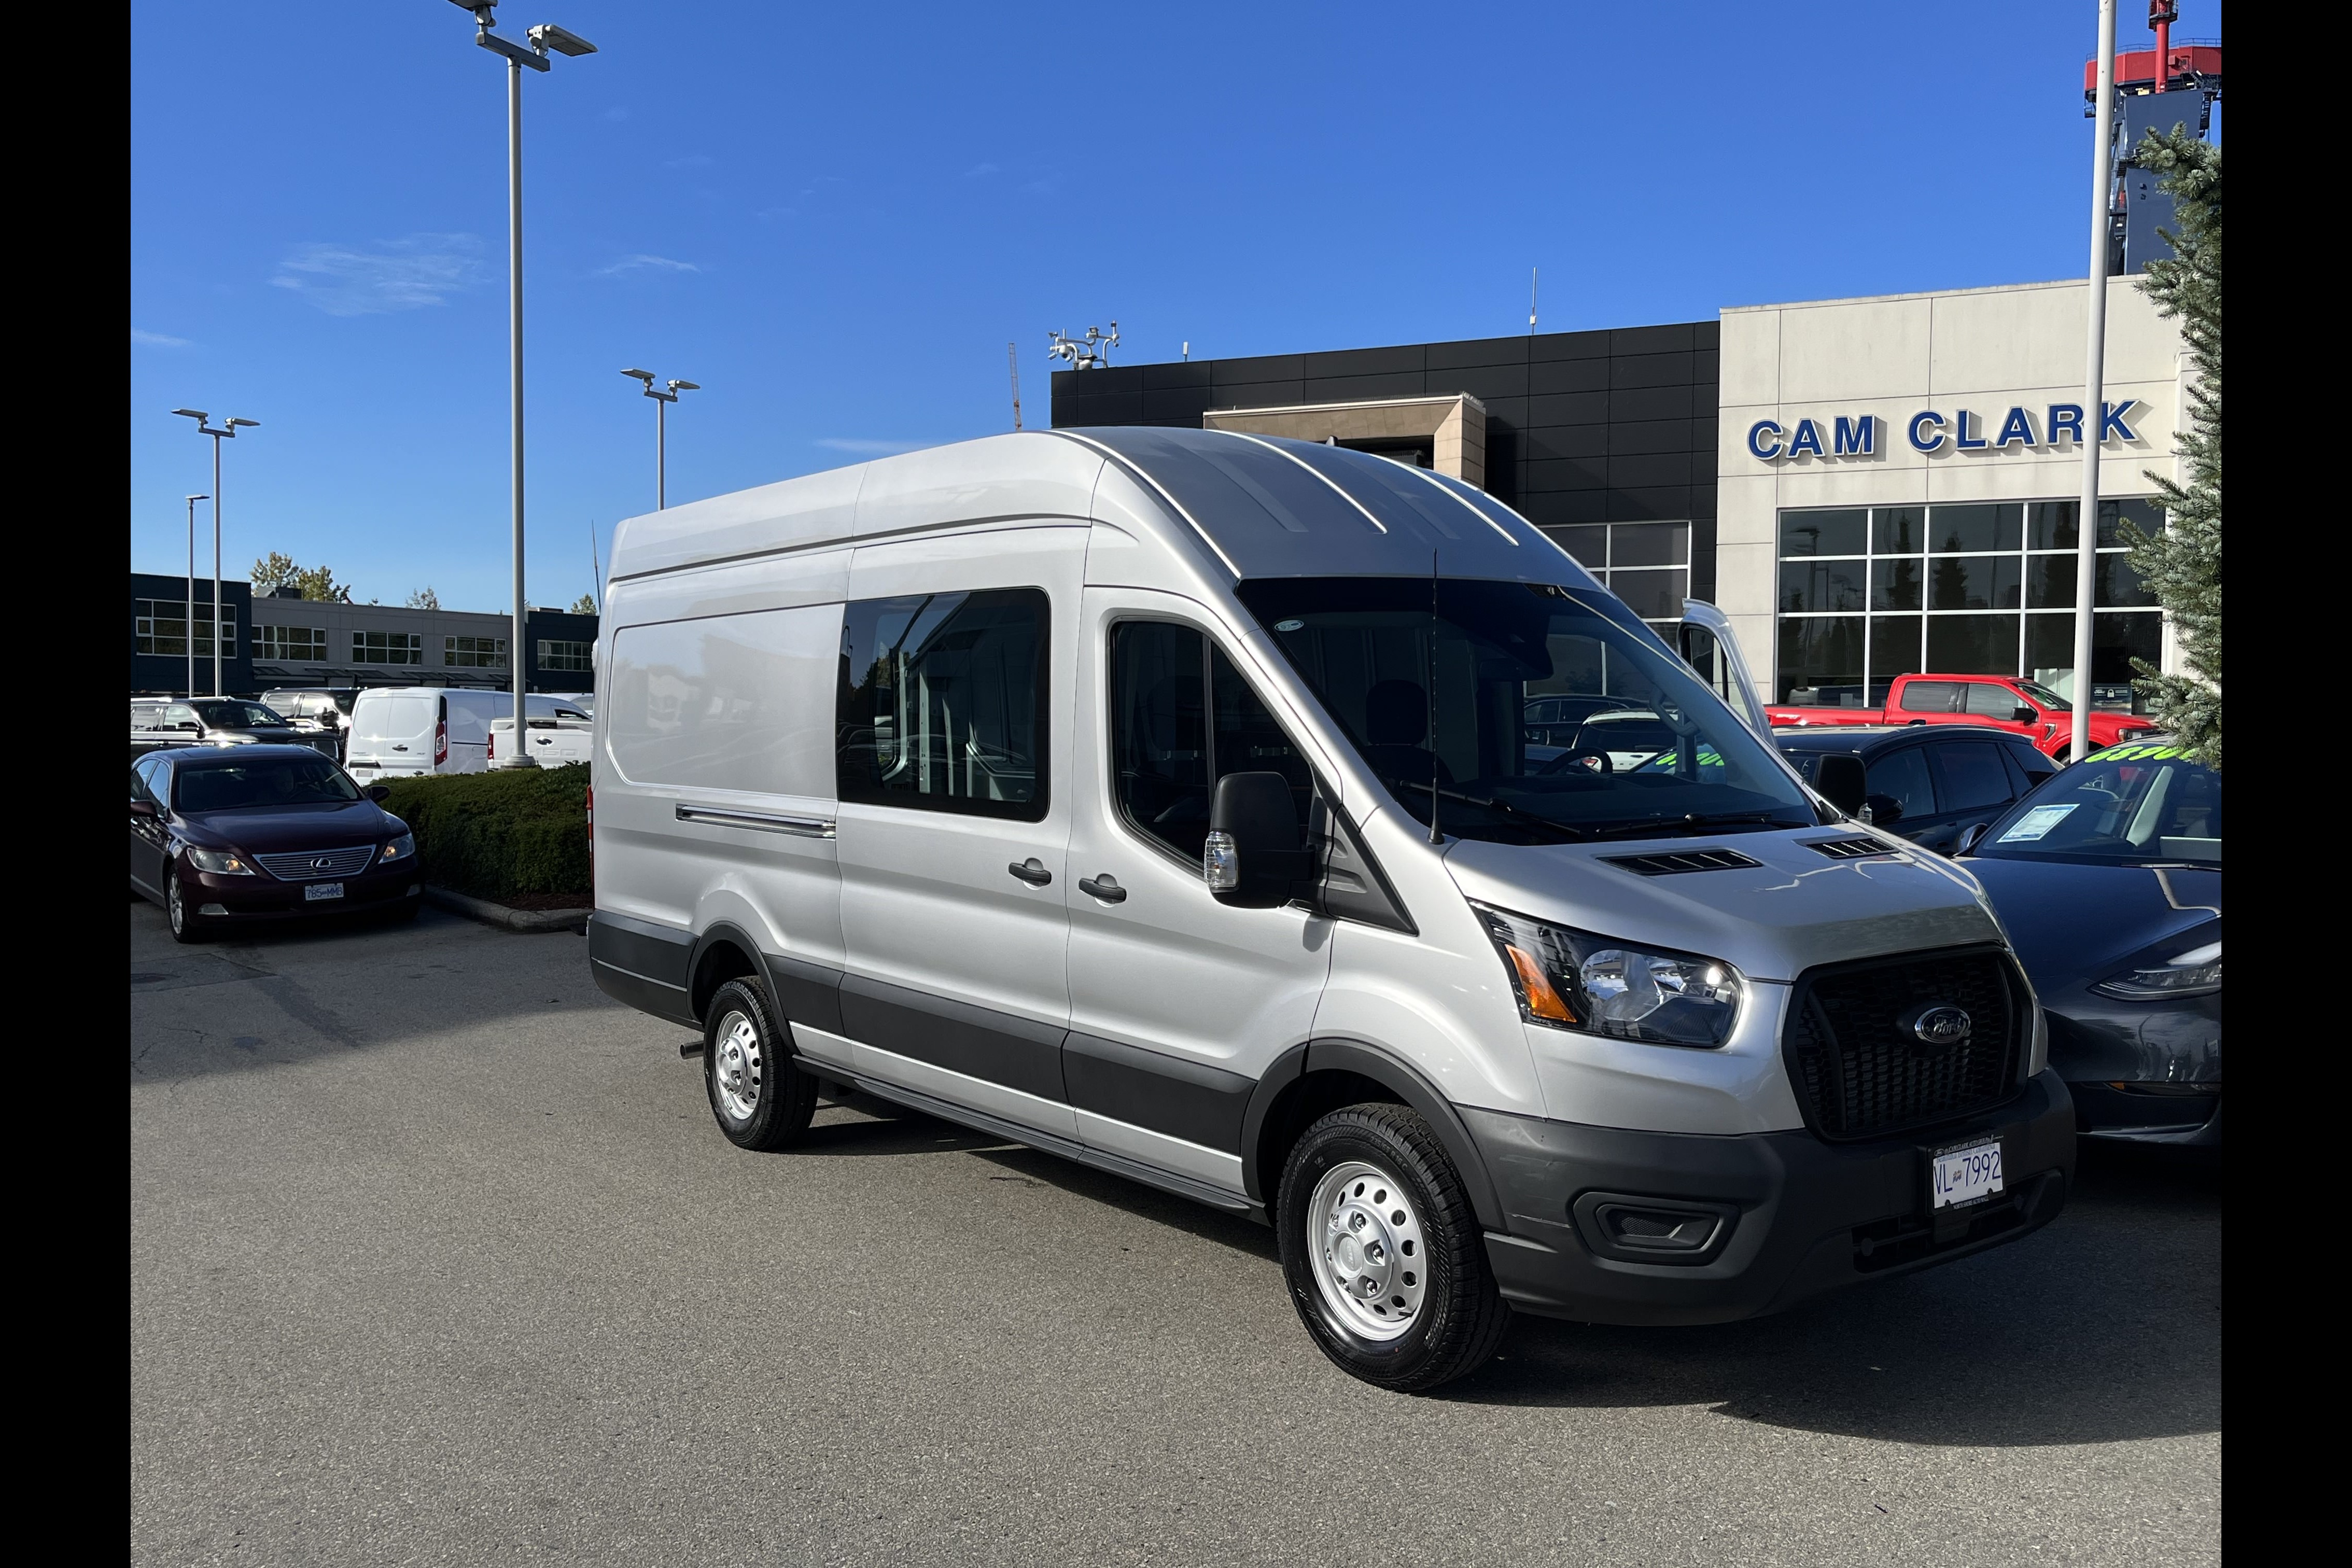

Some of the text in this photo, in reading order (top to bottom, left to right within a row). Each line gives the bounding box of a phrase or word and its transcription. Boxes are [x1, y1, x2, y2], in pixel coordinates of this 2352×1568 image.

[1747, 399, 2140, 460] CAM CLARK
[306, 888, 321, 899] 785
[1933, 1014, 1963, 1036] Ford
[1933, 1151, 2001, 1195] VL 7992
